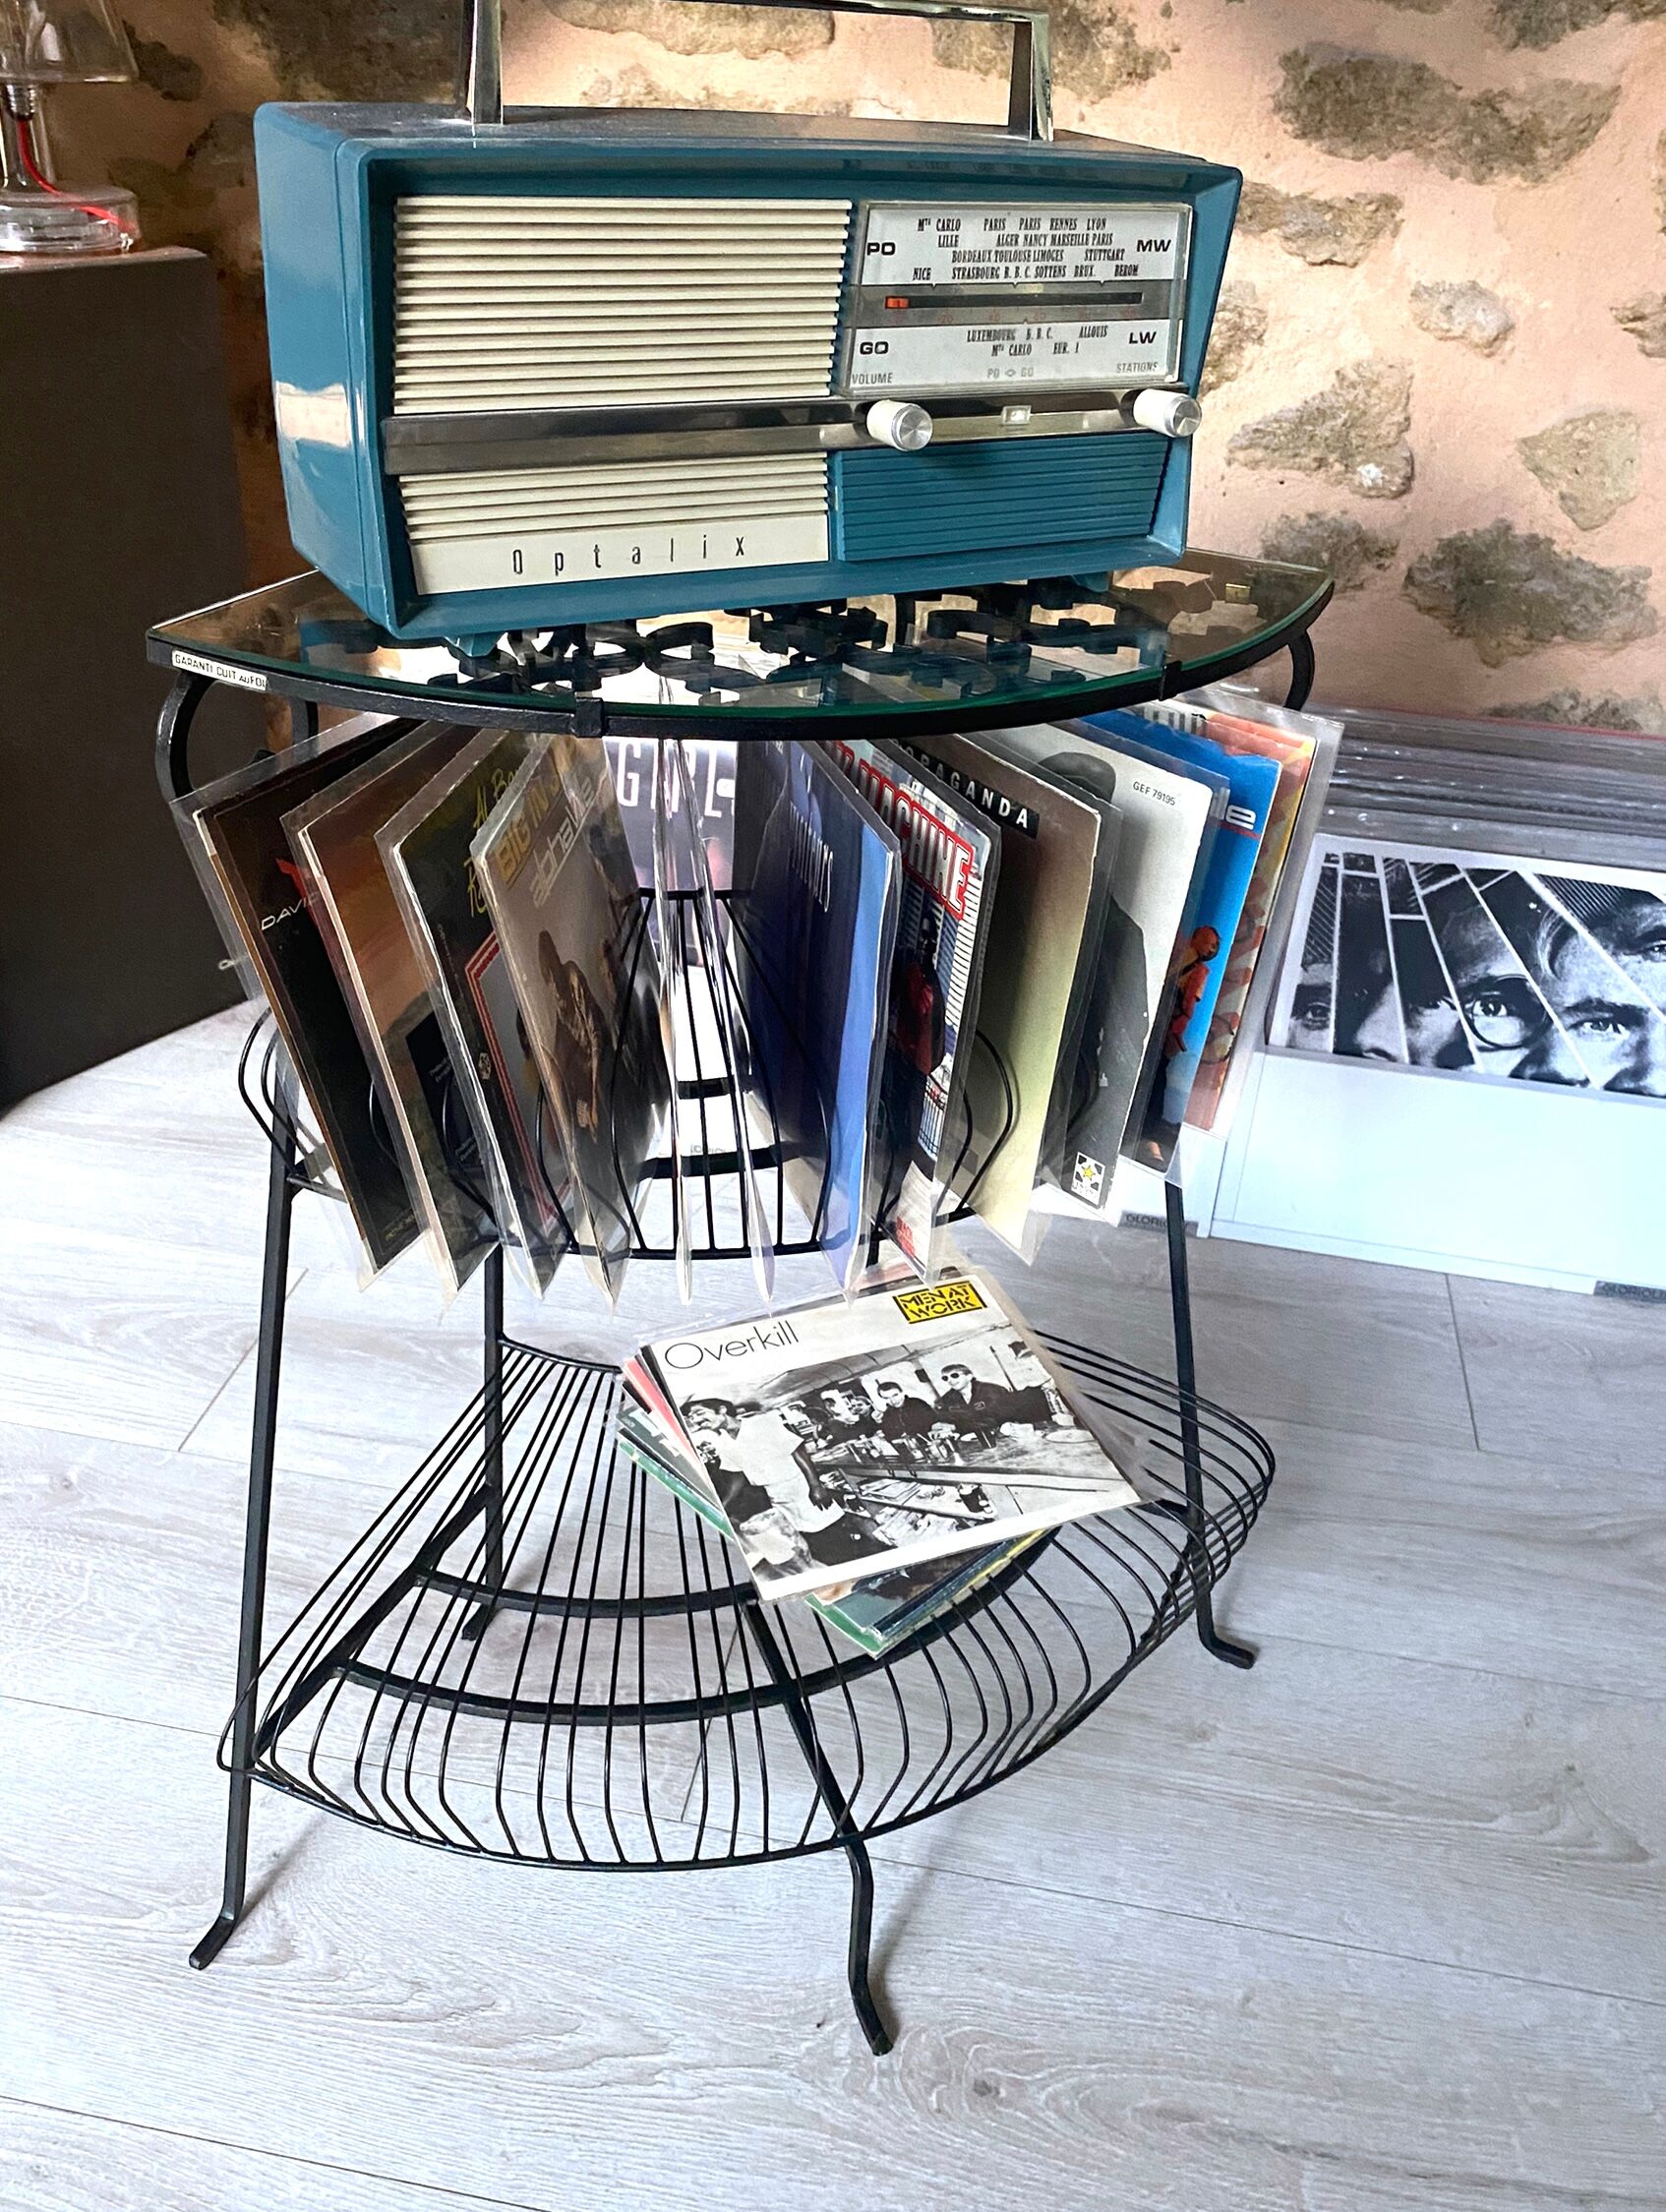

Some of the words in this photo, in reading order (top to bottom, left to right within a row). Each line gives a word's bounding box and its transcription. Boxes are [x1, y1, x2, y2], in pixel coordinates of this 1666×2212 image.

[936, 218, 961, 231] CARLO
[983, 217, 1006, 231] PARIS
[1019, 217, 1041, 231] PARIS
[1049, 217, 1078, 230] RENNES
[1087, 217, 1106, 230] LYON
[938, 235, 959, 248] LILLE
[996, 234, 1019, 247] ALGER
[1023, 234, 1048, 247] NANCY
[1050, 233, 1090, 246] MARSEILLE
[1092, 233, 1113, 246] PARIS
[1137, 239, 1171, 253] MW
[866, 242, 896, 257] PO
[952, 250, 991, 263] BORDEAUX
[994, 249, 1031, 263] TOULOUSE
[1033, 249, 1064, 263] LIMOGES
[1084, 248, 1125, 262] STUTTGART
[913, 268, 931, 280] NICE
[952, 267, 1000, 279] STRASBOURG
[1035, 266, 1066, 278] SOTTENS
[967, 329, 1016, 342] LUXEMBOURG
[1079, 325, 1108, 338] ALLOUIS
[1129, 331, 1157, 344] LW
[860, 341, 889, 355] GO
[1009, 344, 1032, 356] CARLO
[1116, 362, 1159, 374] STATIONS
[852, 373, 893, 385] VOLUME
[512, 534, 744, 577] Optalix
[175, 654, 213, 674] GARANTI
[216, 666, 237, 680] CUIT
[1133, 781, 1151, 799] GEF
[1153, 788, 1176, 807] 79195
[900, 1289, 946, 1309] MEN
[949, 1285, 969, 1298] AT
[910, 1296, 976, 1318] WORK
[664, 1320, 800, 1370] Overkill
